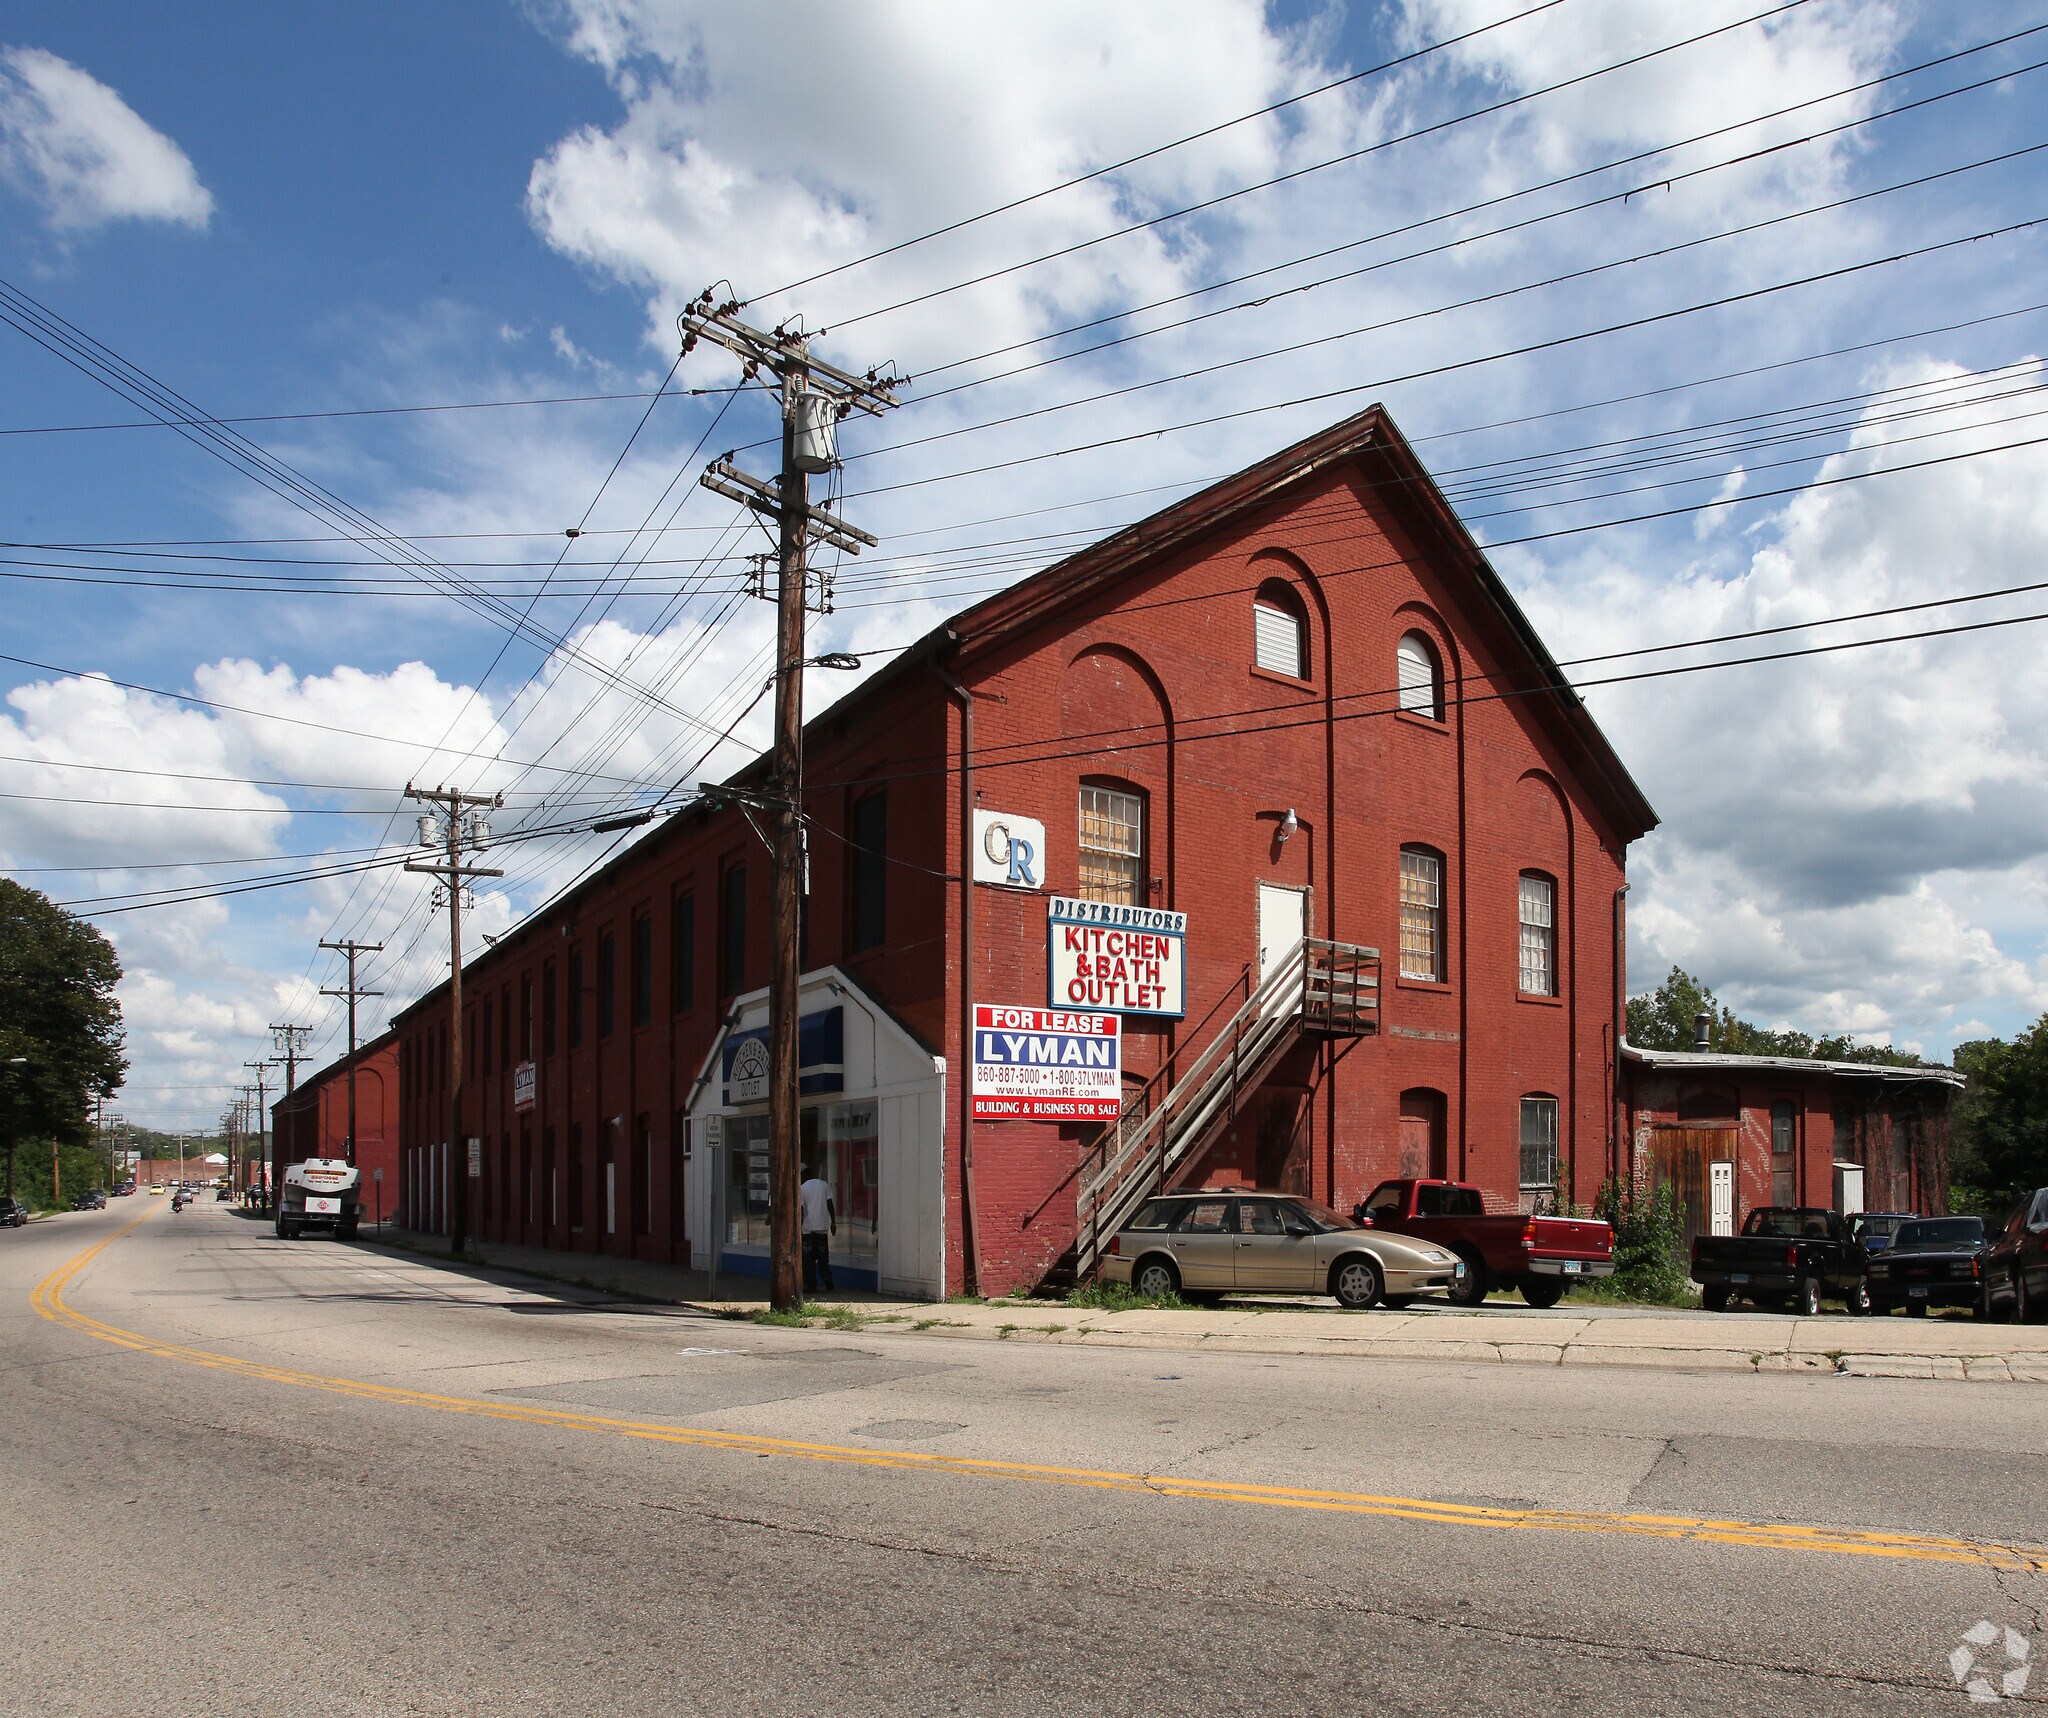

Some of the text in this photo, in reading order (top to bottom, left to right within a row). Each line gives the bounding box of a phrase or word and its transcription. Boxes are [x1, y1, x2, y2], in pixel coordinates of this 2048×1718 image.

[1054, 899, 1183, 930] DISTRIBUTORS
[1065, 926, 1170, 960] KITCHEN
[1068, 977, 1167, 1009] OUTLET
[992, 1009, 1104, 1034] FOR LEASE
[983, 1034, 1109, 1066] LYMAN
[741, 1080, 760, 1097] OUTLET
[977, 1066, 1115, 1087] 860-887-5000 1-800-37LYMAN
[996, 1086, 1100, 1098] www.LymanRE.com
[975, 1101, 1118, 1115] BUILDING & BUSINESS FOR SALE
